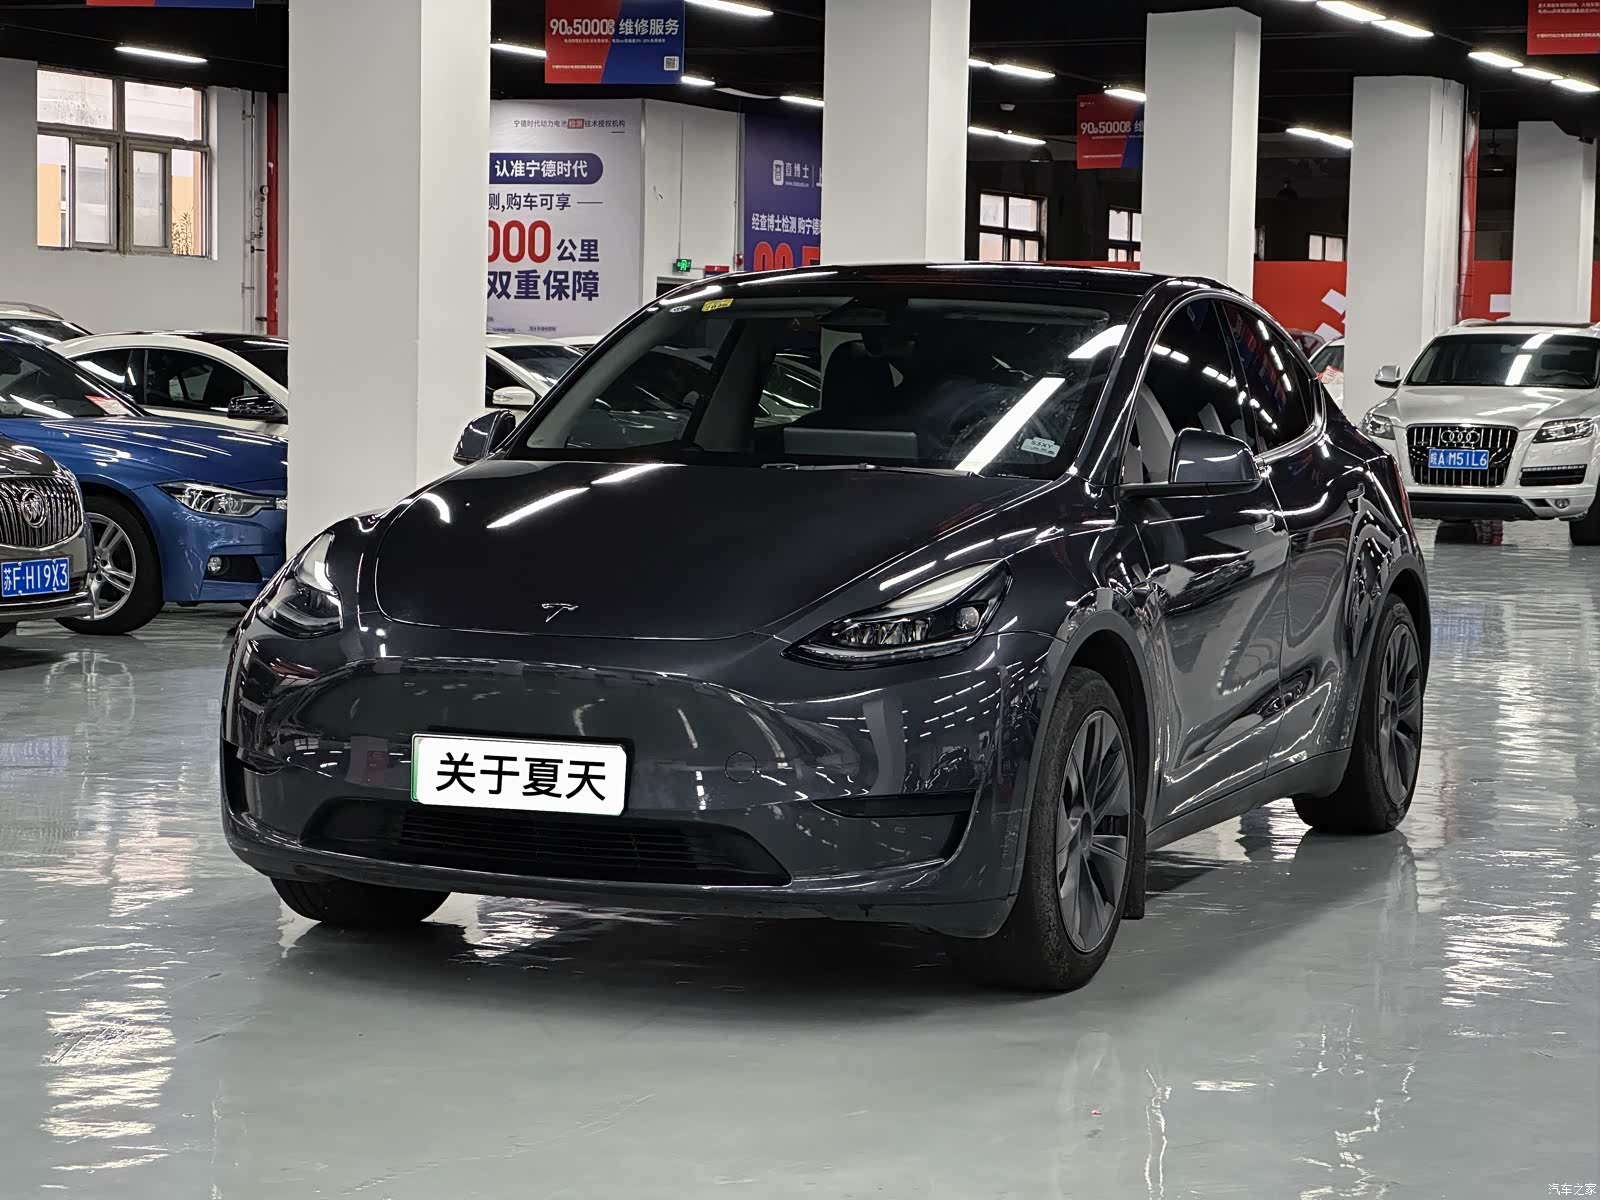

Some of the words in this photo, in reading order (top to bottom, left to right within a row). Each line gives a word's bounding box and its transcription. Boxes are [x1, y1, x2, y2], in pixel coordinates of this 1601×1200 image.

[619, 18, 680, 36] 维修服务
[494, 160, 588, 178] 认准宁德时代
[556, 239, 600, 263] 公里
[487, 269, 600, 301] 双重保障
[4, 563, 68, 591] 苏F·H19X3
